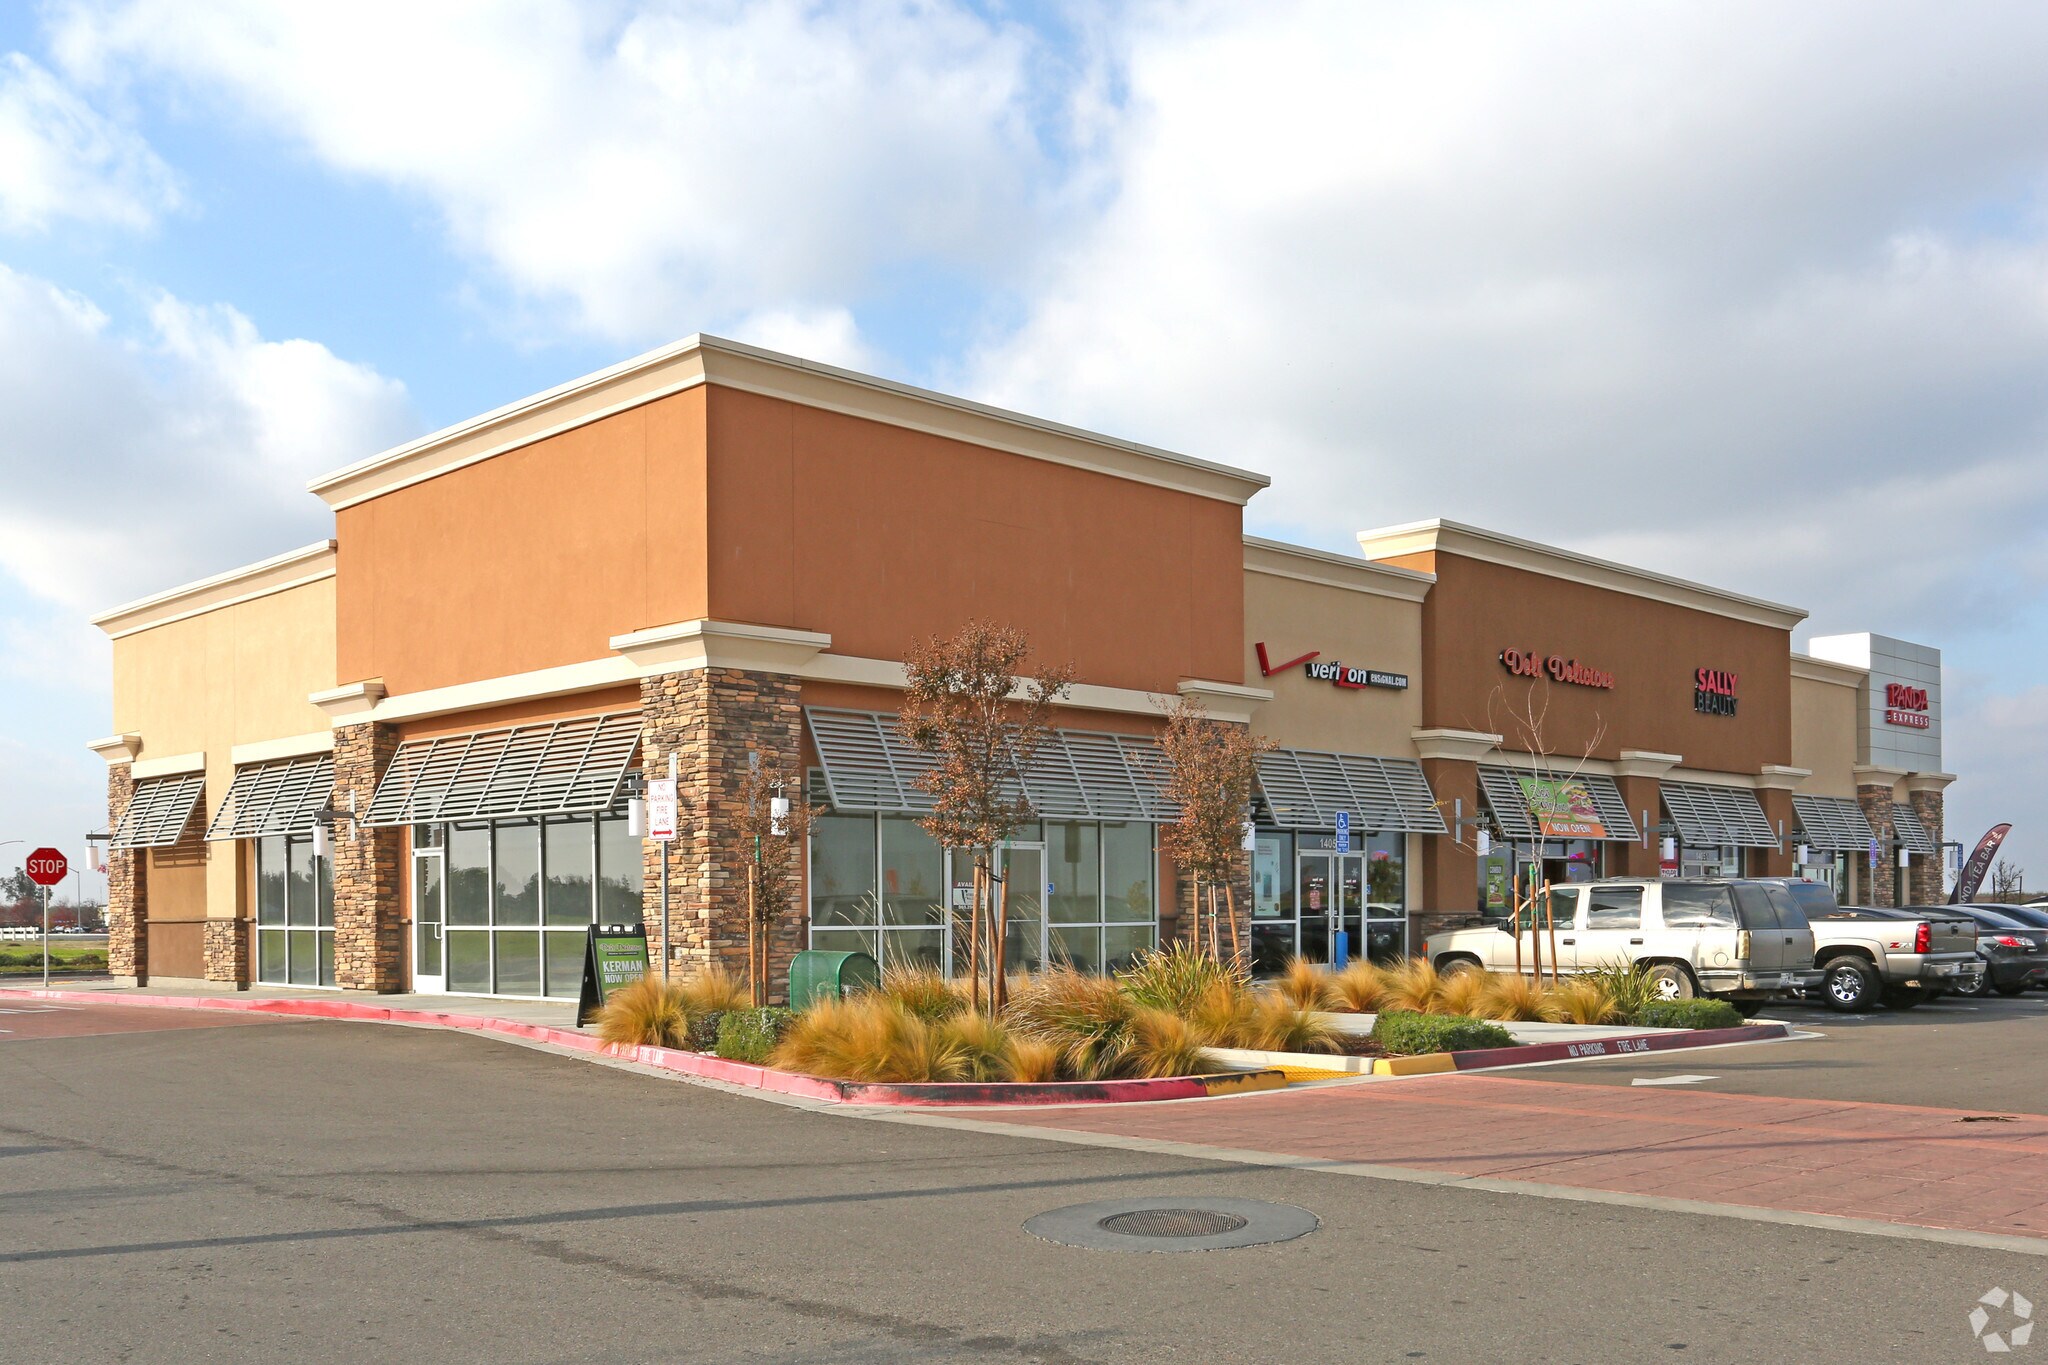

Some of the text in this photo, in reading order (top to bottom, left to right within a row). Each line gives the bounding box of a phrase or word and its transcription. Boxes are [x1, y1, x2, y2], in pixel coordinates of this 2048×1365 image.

[1311, 661, 1367, 690] verizon
[1503, 647, 1615, 689] Deli Delicious
[1698, 667, 1738, 697] SALLY
[1697, 692, 1738, 715] BEAUTY
[1890, 683, 1928, 711] PANDA
[1893, 712, 1928, 727] EXPRESS
[1551, 823, 1570, 832] NOW
[1980, 840, 1995, 860] BAR
[29, 859, 65, 874] STOP
[602, 960, 643, 973] KERMAN
[604, 973, 644, 984] NOW OPEN
[1567, 1039, 1649, 1057] NO PARKING FIRE LANE
